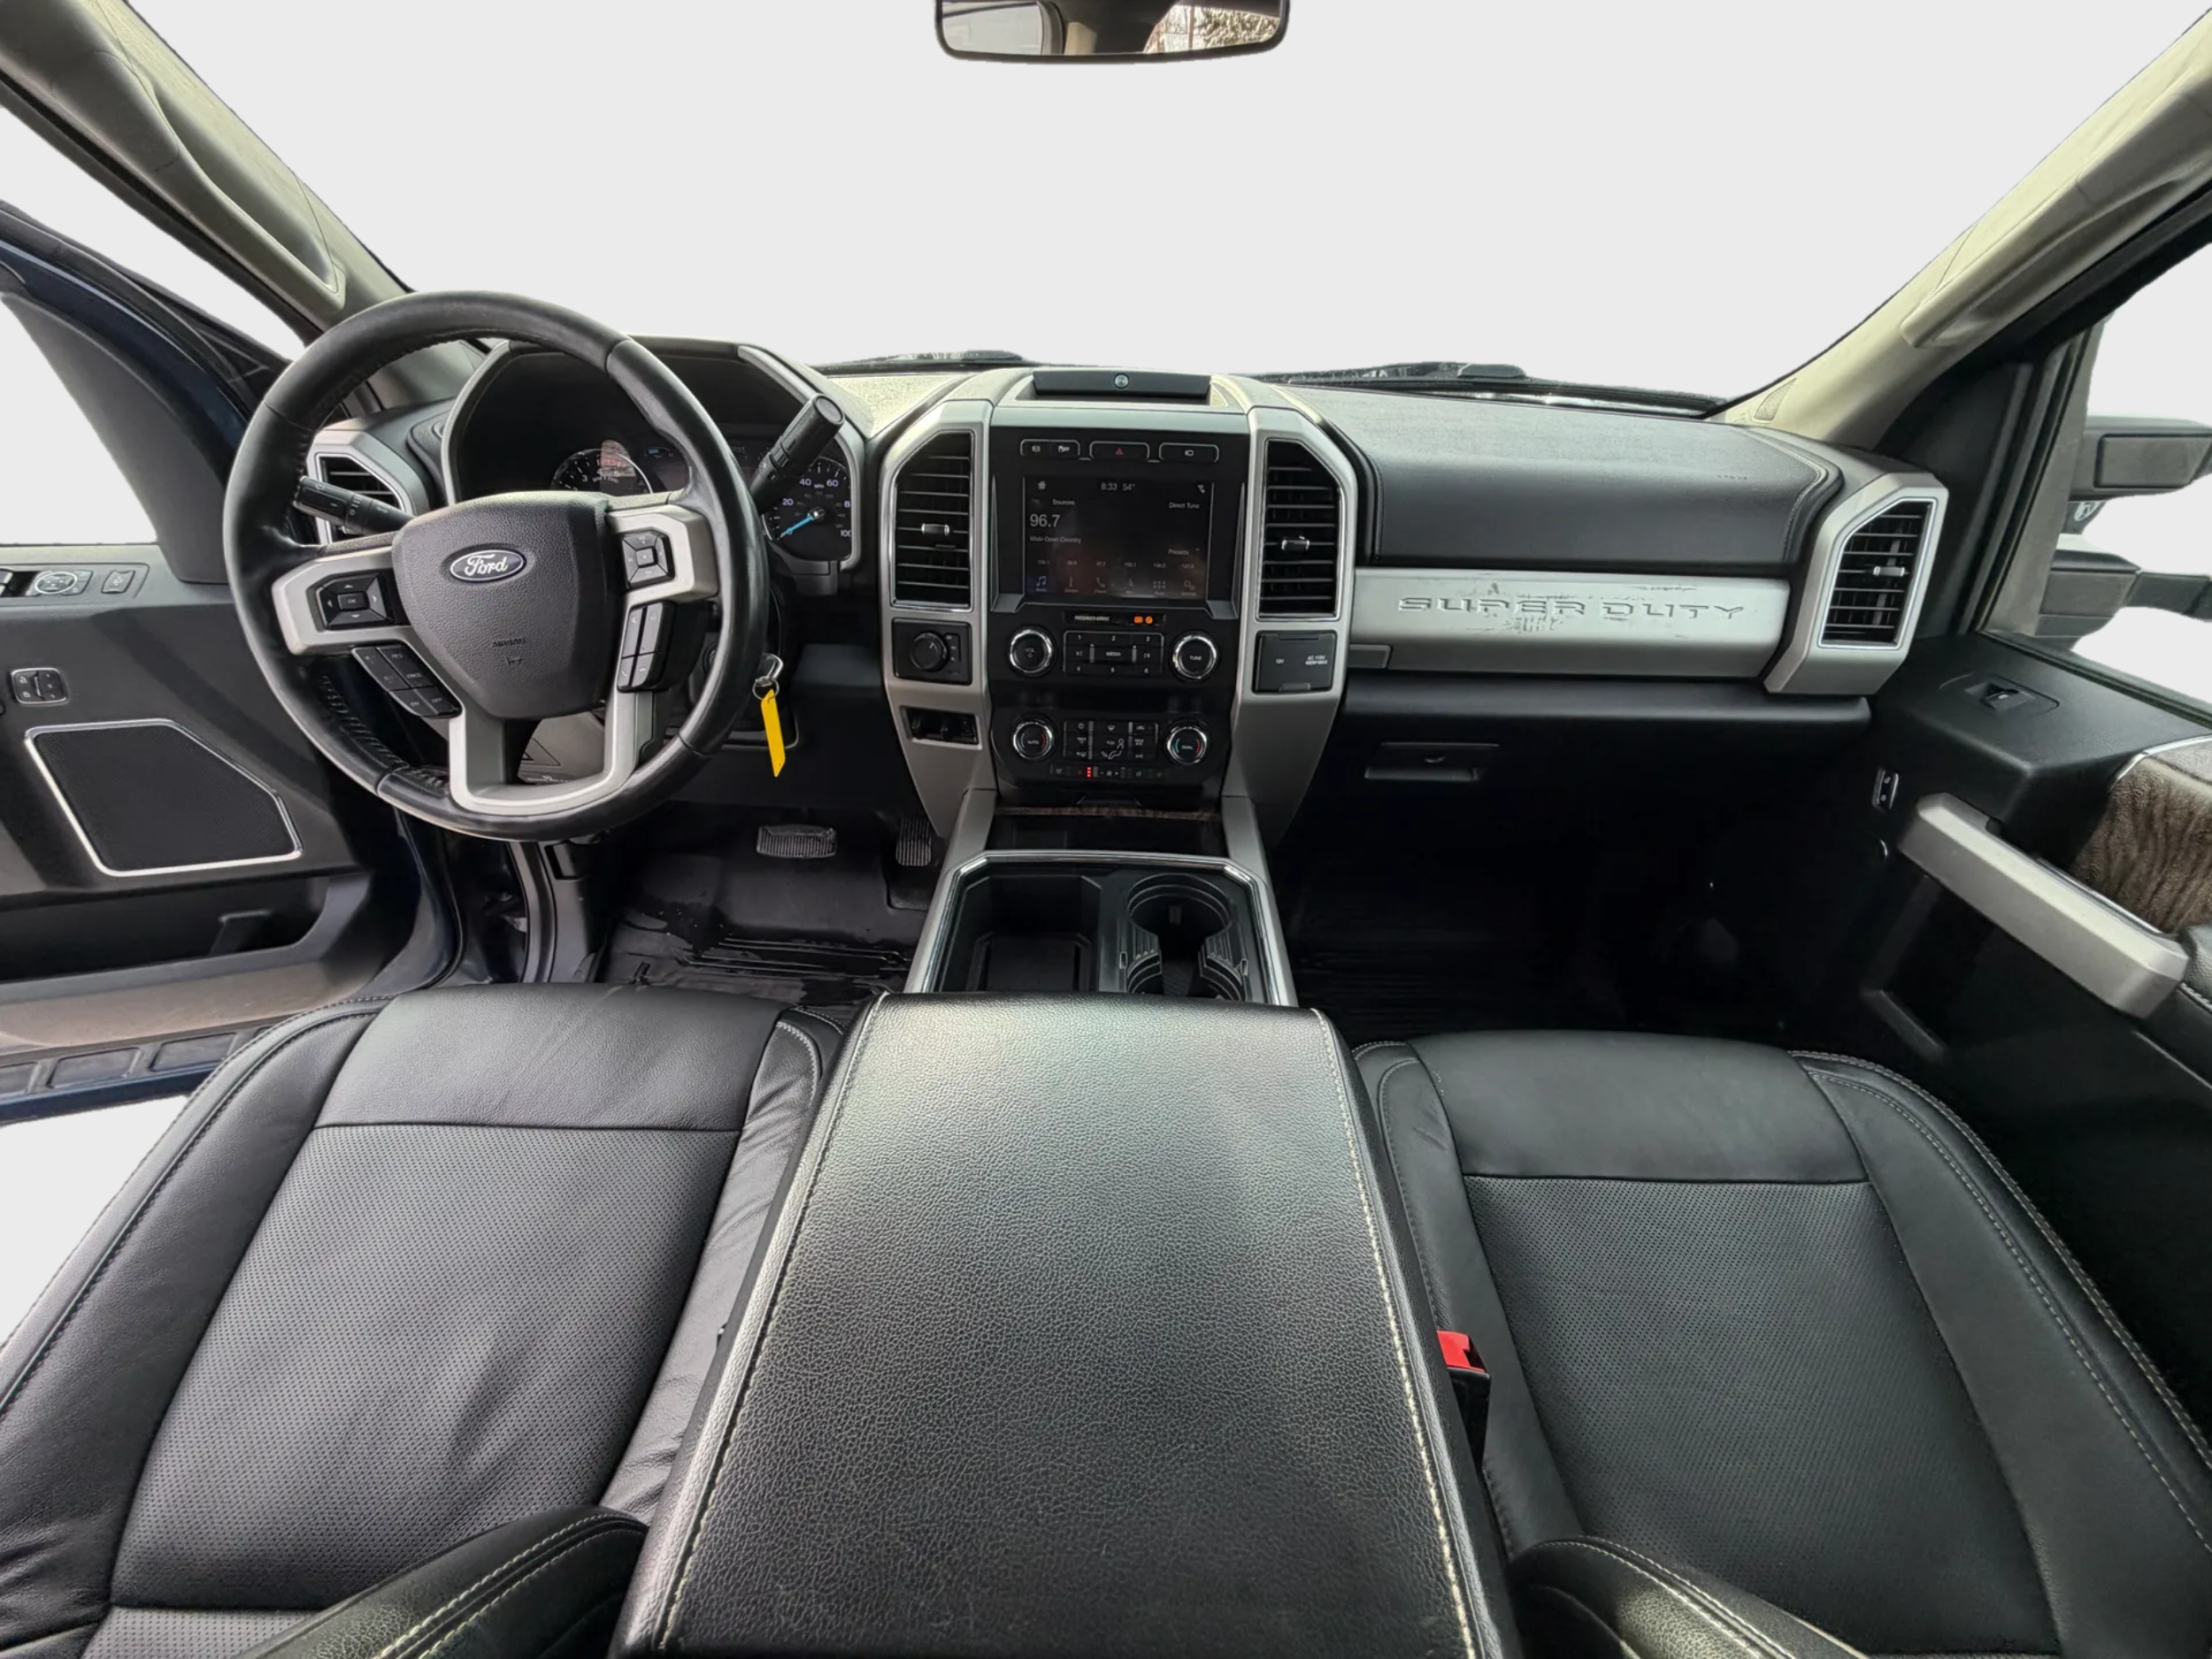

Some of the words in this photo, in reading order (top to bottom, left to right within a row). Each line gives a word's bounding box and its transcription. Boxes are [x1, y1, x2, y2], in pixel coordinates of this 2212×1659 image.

[581, 473, 588, 482] 3
[826, 479, 840, 488] 60
[1100, 482, 1118, 491] 8:33
[1029, 513, 1061, 527] 96.7
[465, 554, 509, 577] Ford
[1398, 596, 1586, 617] SUPER
[1601, 602, 1745, 620] DUTY
